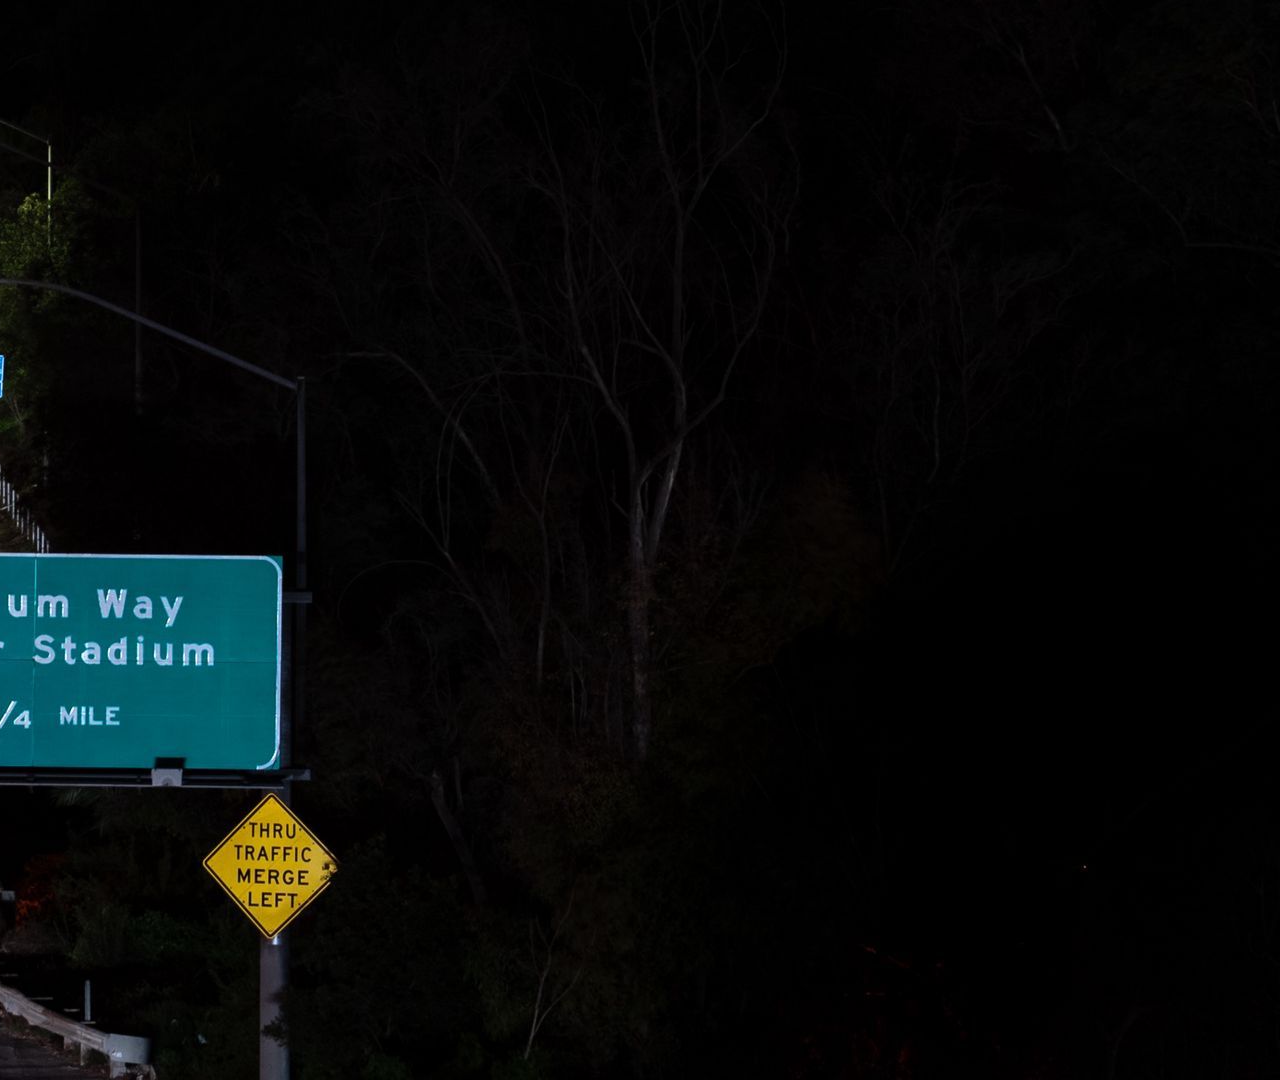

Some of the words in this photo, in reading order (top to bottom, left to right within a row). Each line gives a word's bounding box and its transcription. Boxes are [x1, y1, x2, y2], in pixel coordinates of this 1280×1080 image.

[97, 589, 183, 627] Way
[33, 634, 214, 666] Stadium
[59, 706, 120, 725] MILE
[249, 822, 296, 839] THRU
[234, 845, 312, 863] TRAFFIC
[237, 868, 309, 885] MERGE
[248, 891, 298, 908] LEFT
